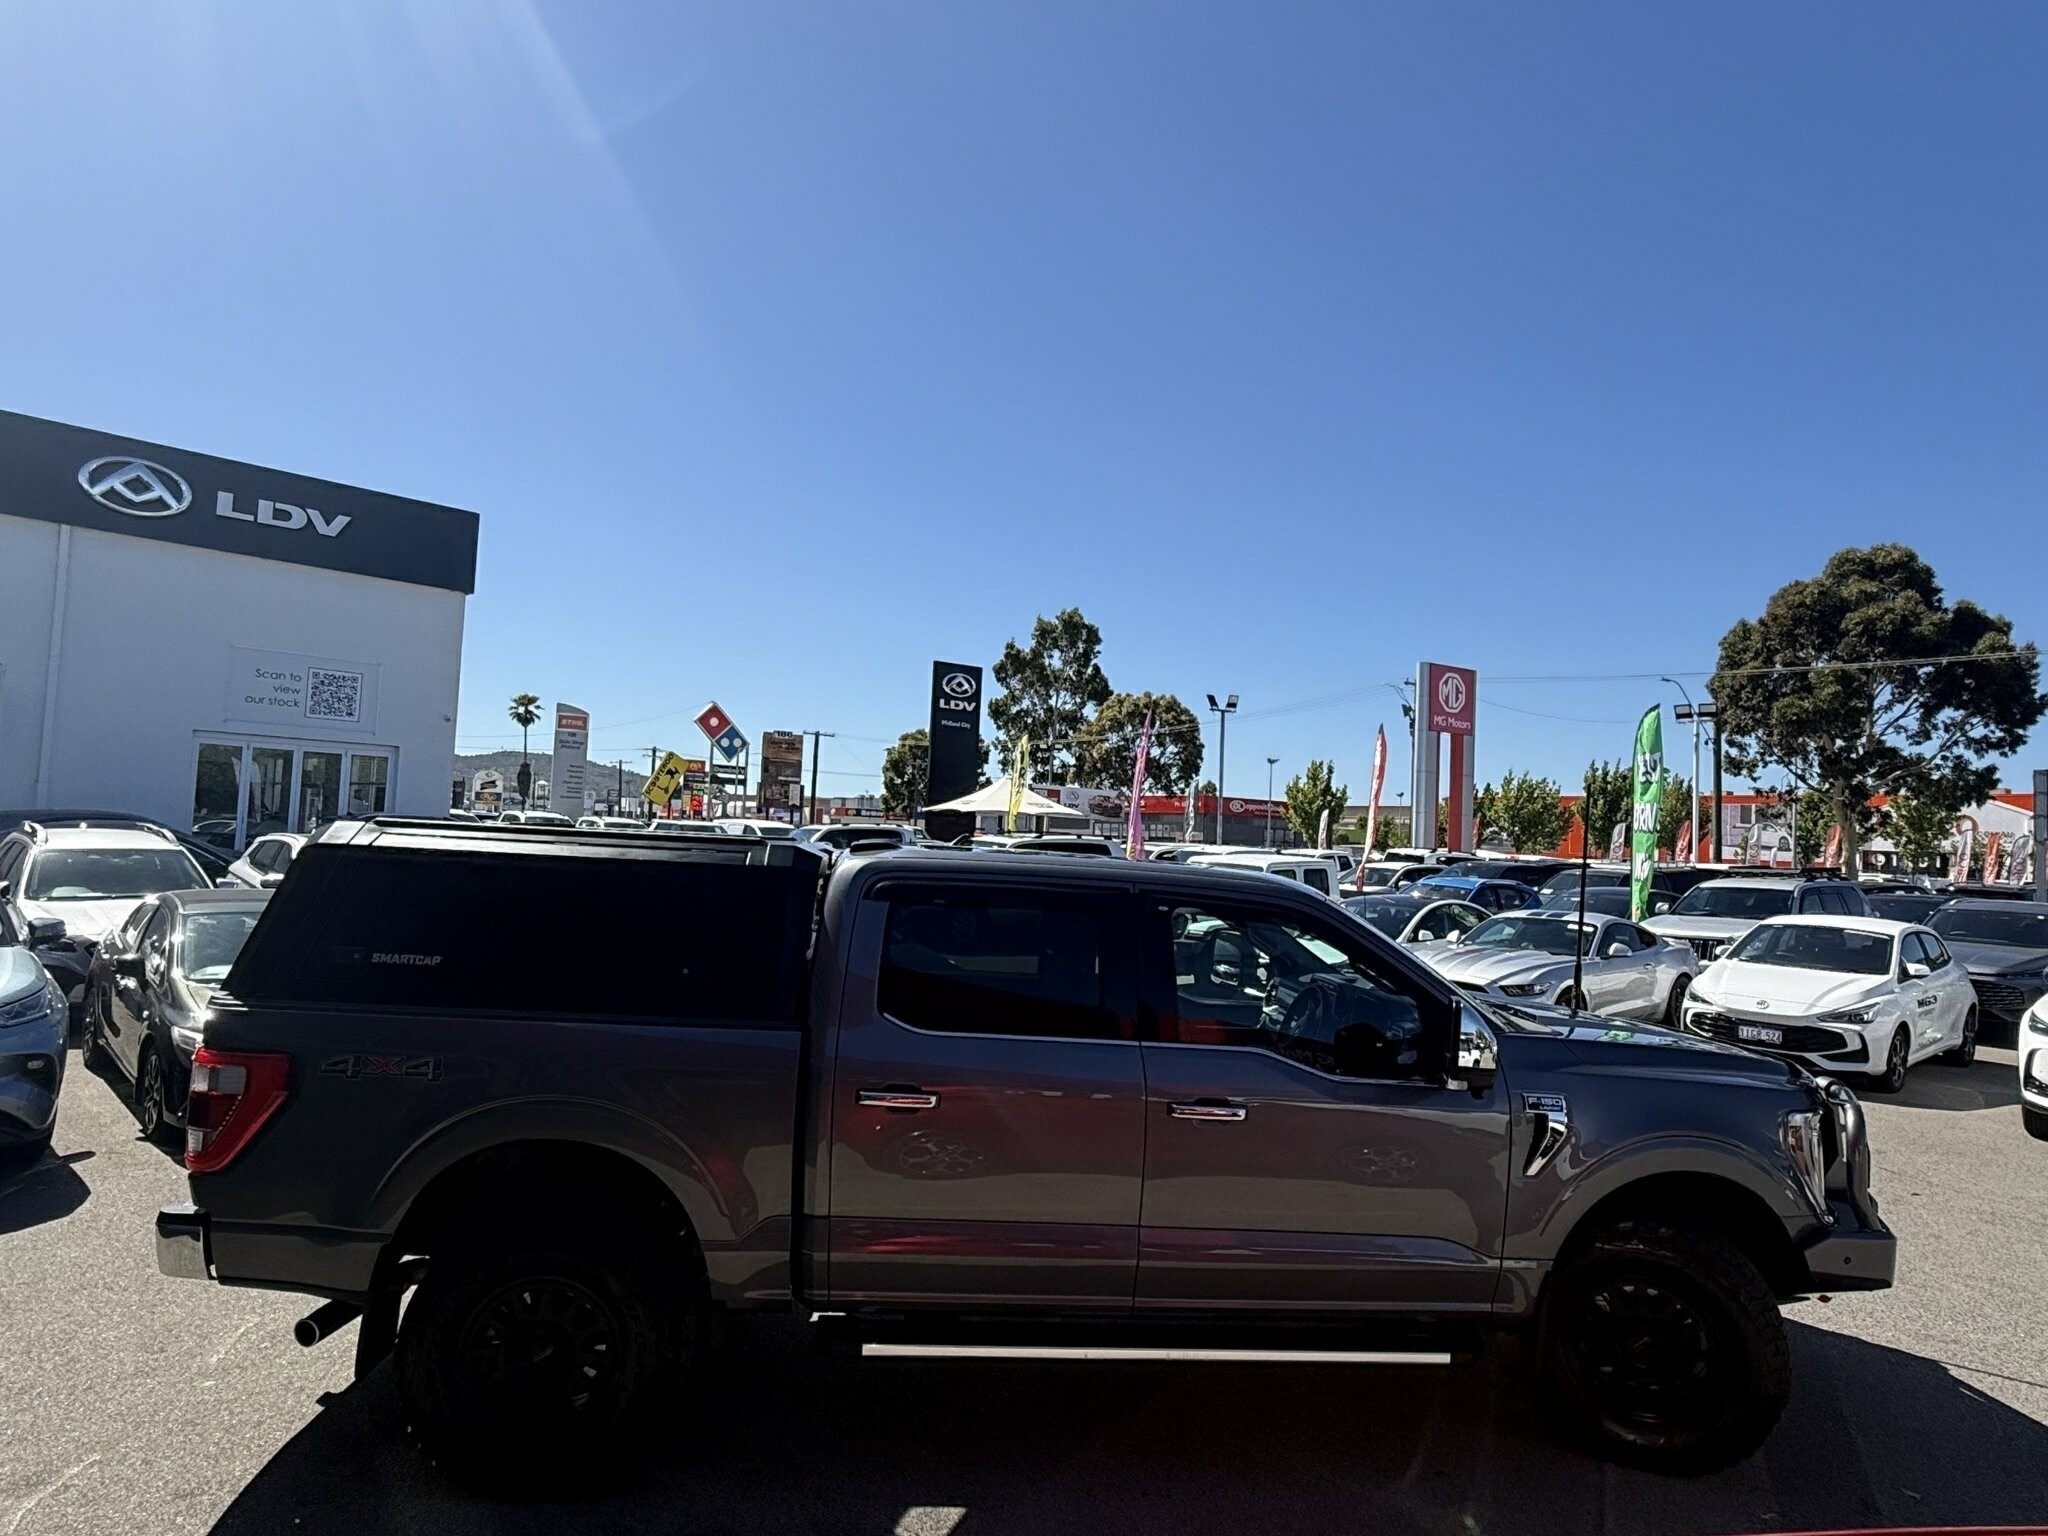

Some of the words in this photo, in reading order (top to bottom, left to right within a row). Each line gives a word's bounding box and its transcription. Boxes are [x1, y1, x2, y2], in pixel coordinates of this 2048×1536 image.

[216, 491, 353, 538] LDV
[255, 667, 286, 681] Scan
[290, 671, 303, 683] to
[273, 684, 301, 695] view
[244, 694, 265, 705] our
[267, 695, 300, 708] stock
[939, 698, 977, 712] LDV
[560, 718, 585, 727] STIHL
[941, 719, 960, 729] Midland
[960, 721, 972, 730] City
[1434, 714, 1447, 726] MG
[1447, 717, 1472, 730] Motors
[776, 730, 793, 738] 186
[371, 953, 443, 966] SMARTCAP
[1916, 994, 1938, 1009] MG3
[1765, 1031, 1781, 1043] 524
[1528, 1096, 1562, 1105] F-150
